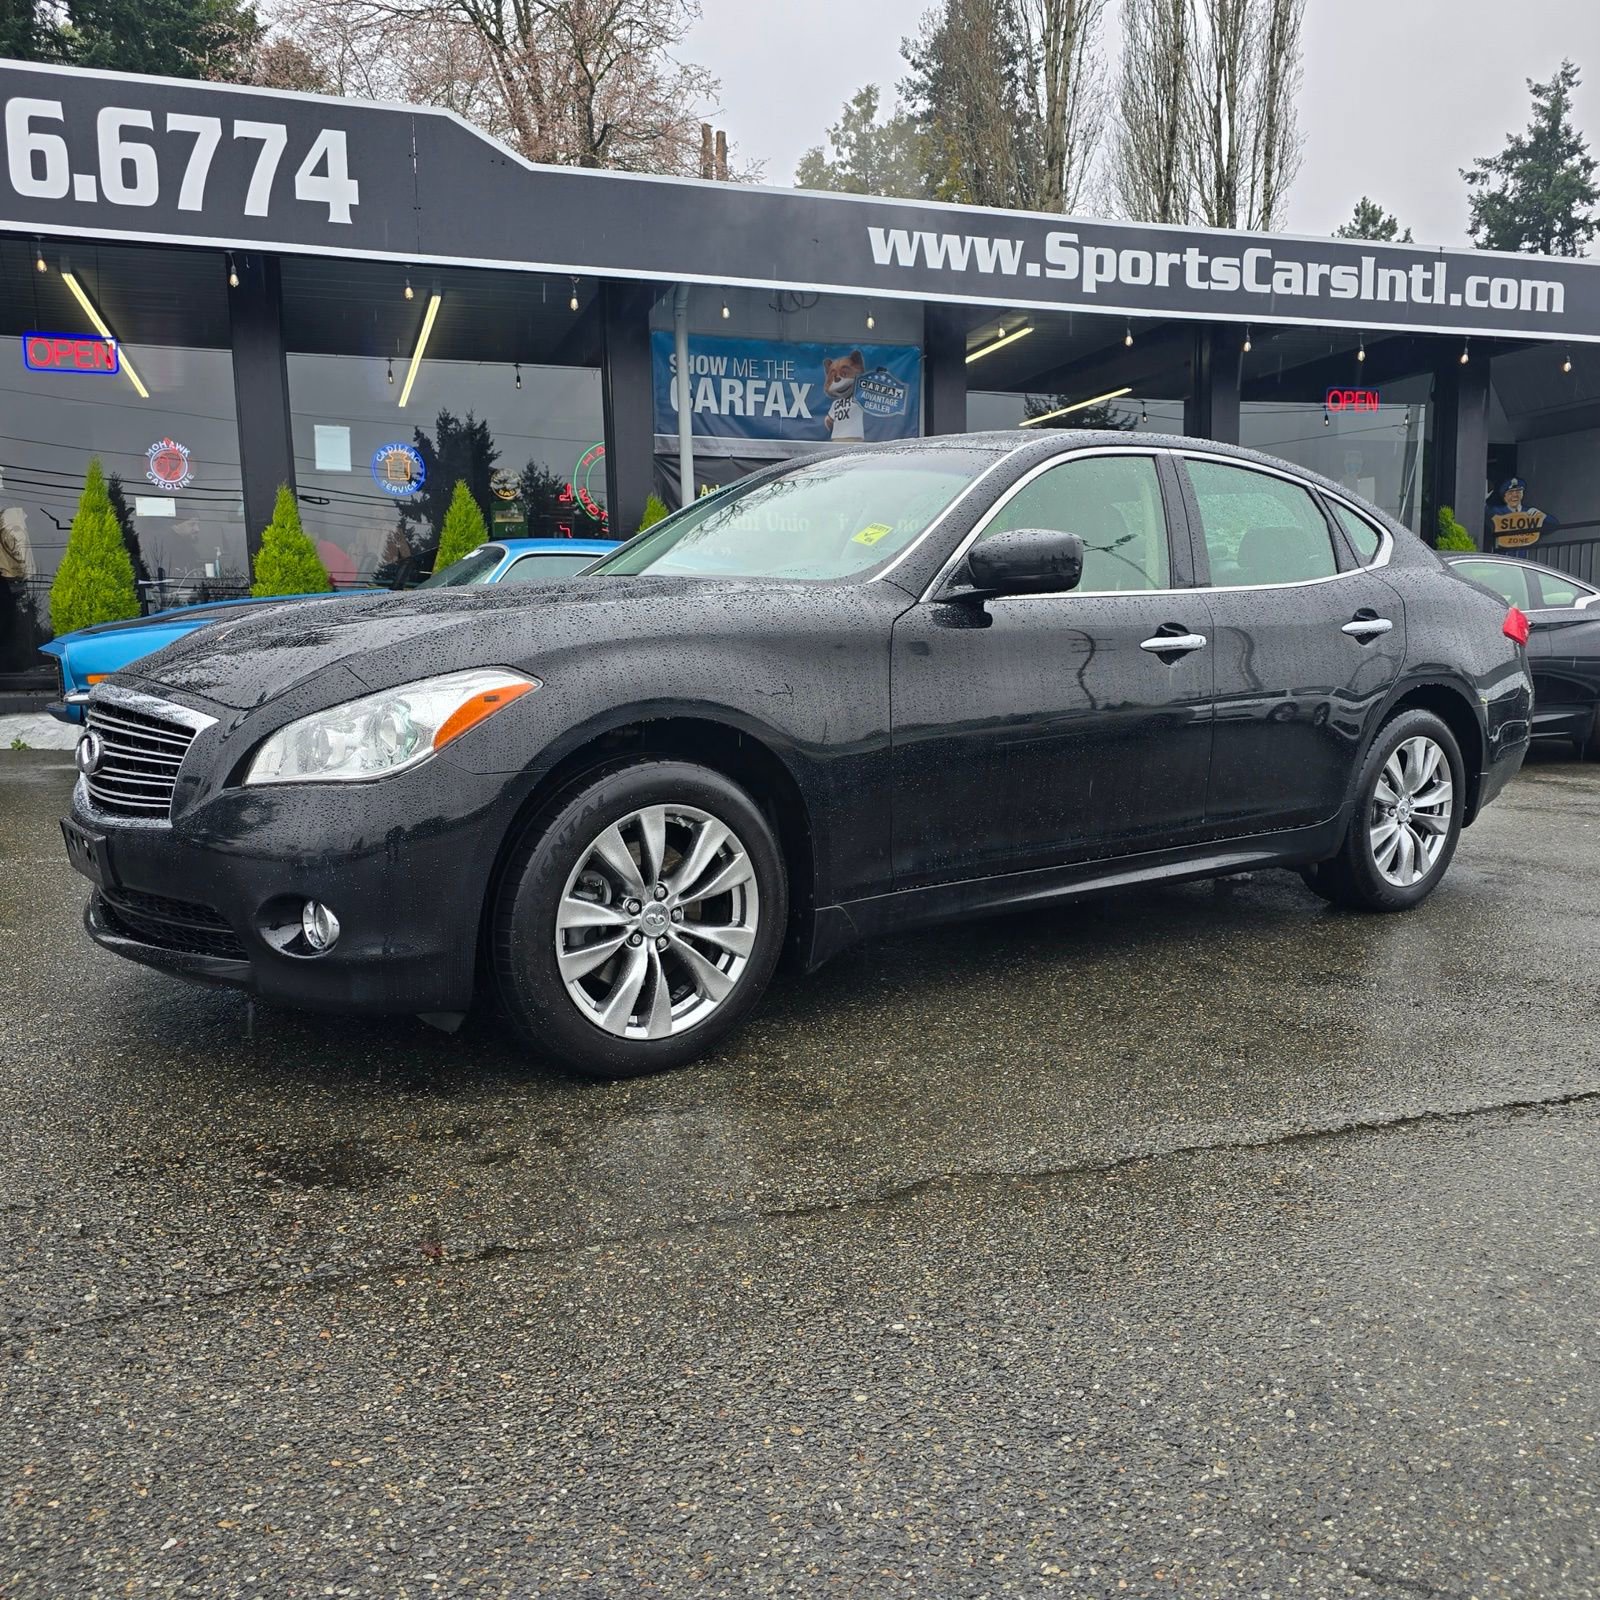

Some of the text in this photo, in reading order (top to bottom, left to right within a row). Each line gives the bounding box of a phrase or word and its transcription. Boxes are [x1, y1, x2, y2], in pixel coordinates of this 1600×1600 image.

[5, 97, 359, 224] 6.6774
[867, 227, 1565, 313] www.SportsCarsIntl.com
[28, 337, 116, 370] OPEN
[733, 358, 760, 378] ME
[763, 360, 795, 380] THE
[670, 375, 813, 419] CARFAX
[860, 381, 904, 399] CARFAX
[860, 391, 899, 407] ADVANTAGE
[864, 401, 891, 414] DEALER
[1328, 389, 1378, 412] OPEN
[834, 409, 850, 421] FOX
[145, 440, 191, 458] MOHAWK
[376, 444, 421, 464] CADILLAC
[145, 472, 194, 490] GASOLINE
[382, 479, 418, 493] SERVICE
[1500, 517, 1541, 530] SLOW
